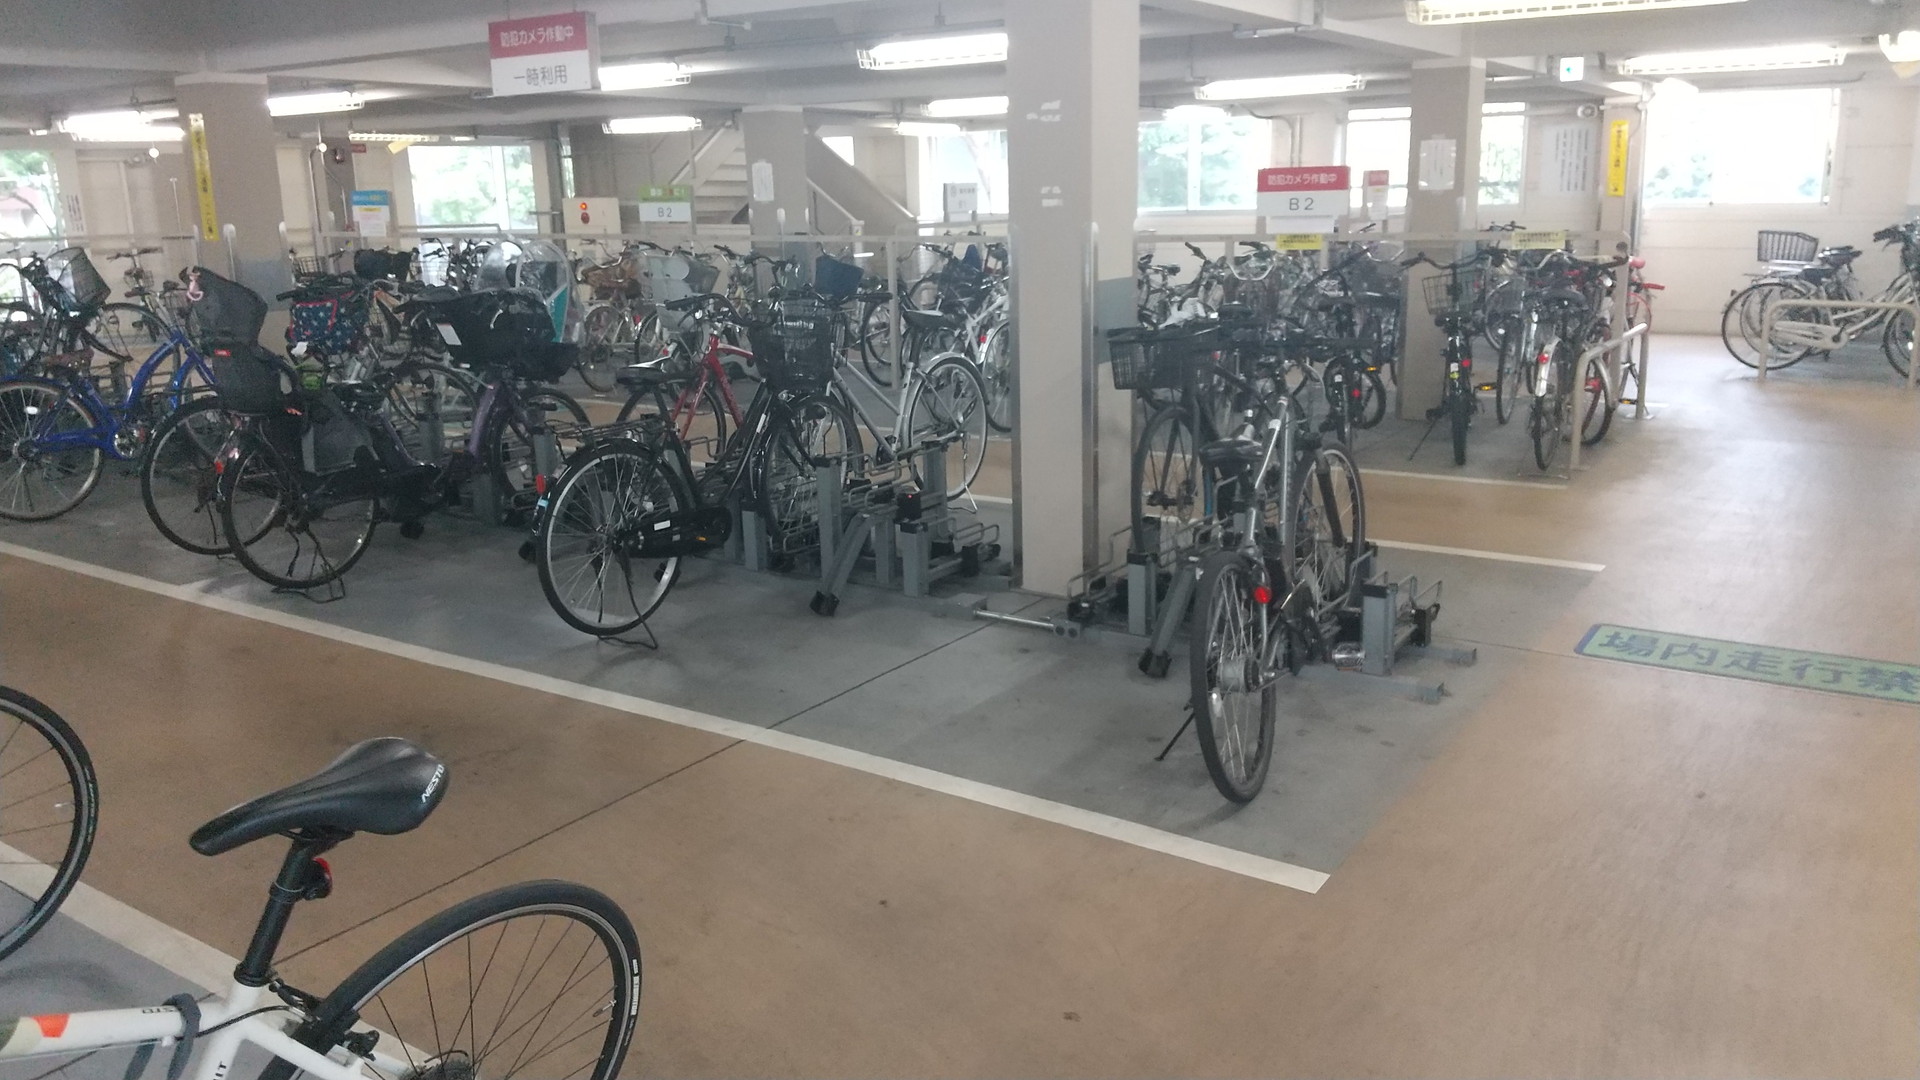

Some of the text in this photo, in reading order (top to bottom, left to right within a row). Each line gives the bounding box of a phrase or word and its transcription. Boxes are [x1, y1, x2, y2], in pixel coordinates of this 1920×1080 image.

[513, 64, 568, 86] 一時利用
[1599, 631, 1920, 694] 場内走行禁
[421, 763, 445, 803] NESTO
